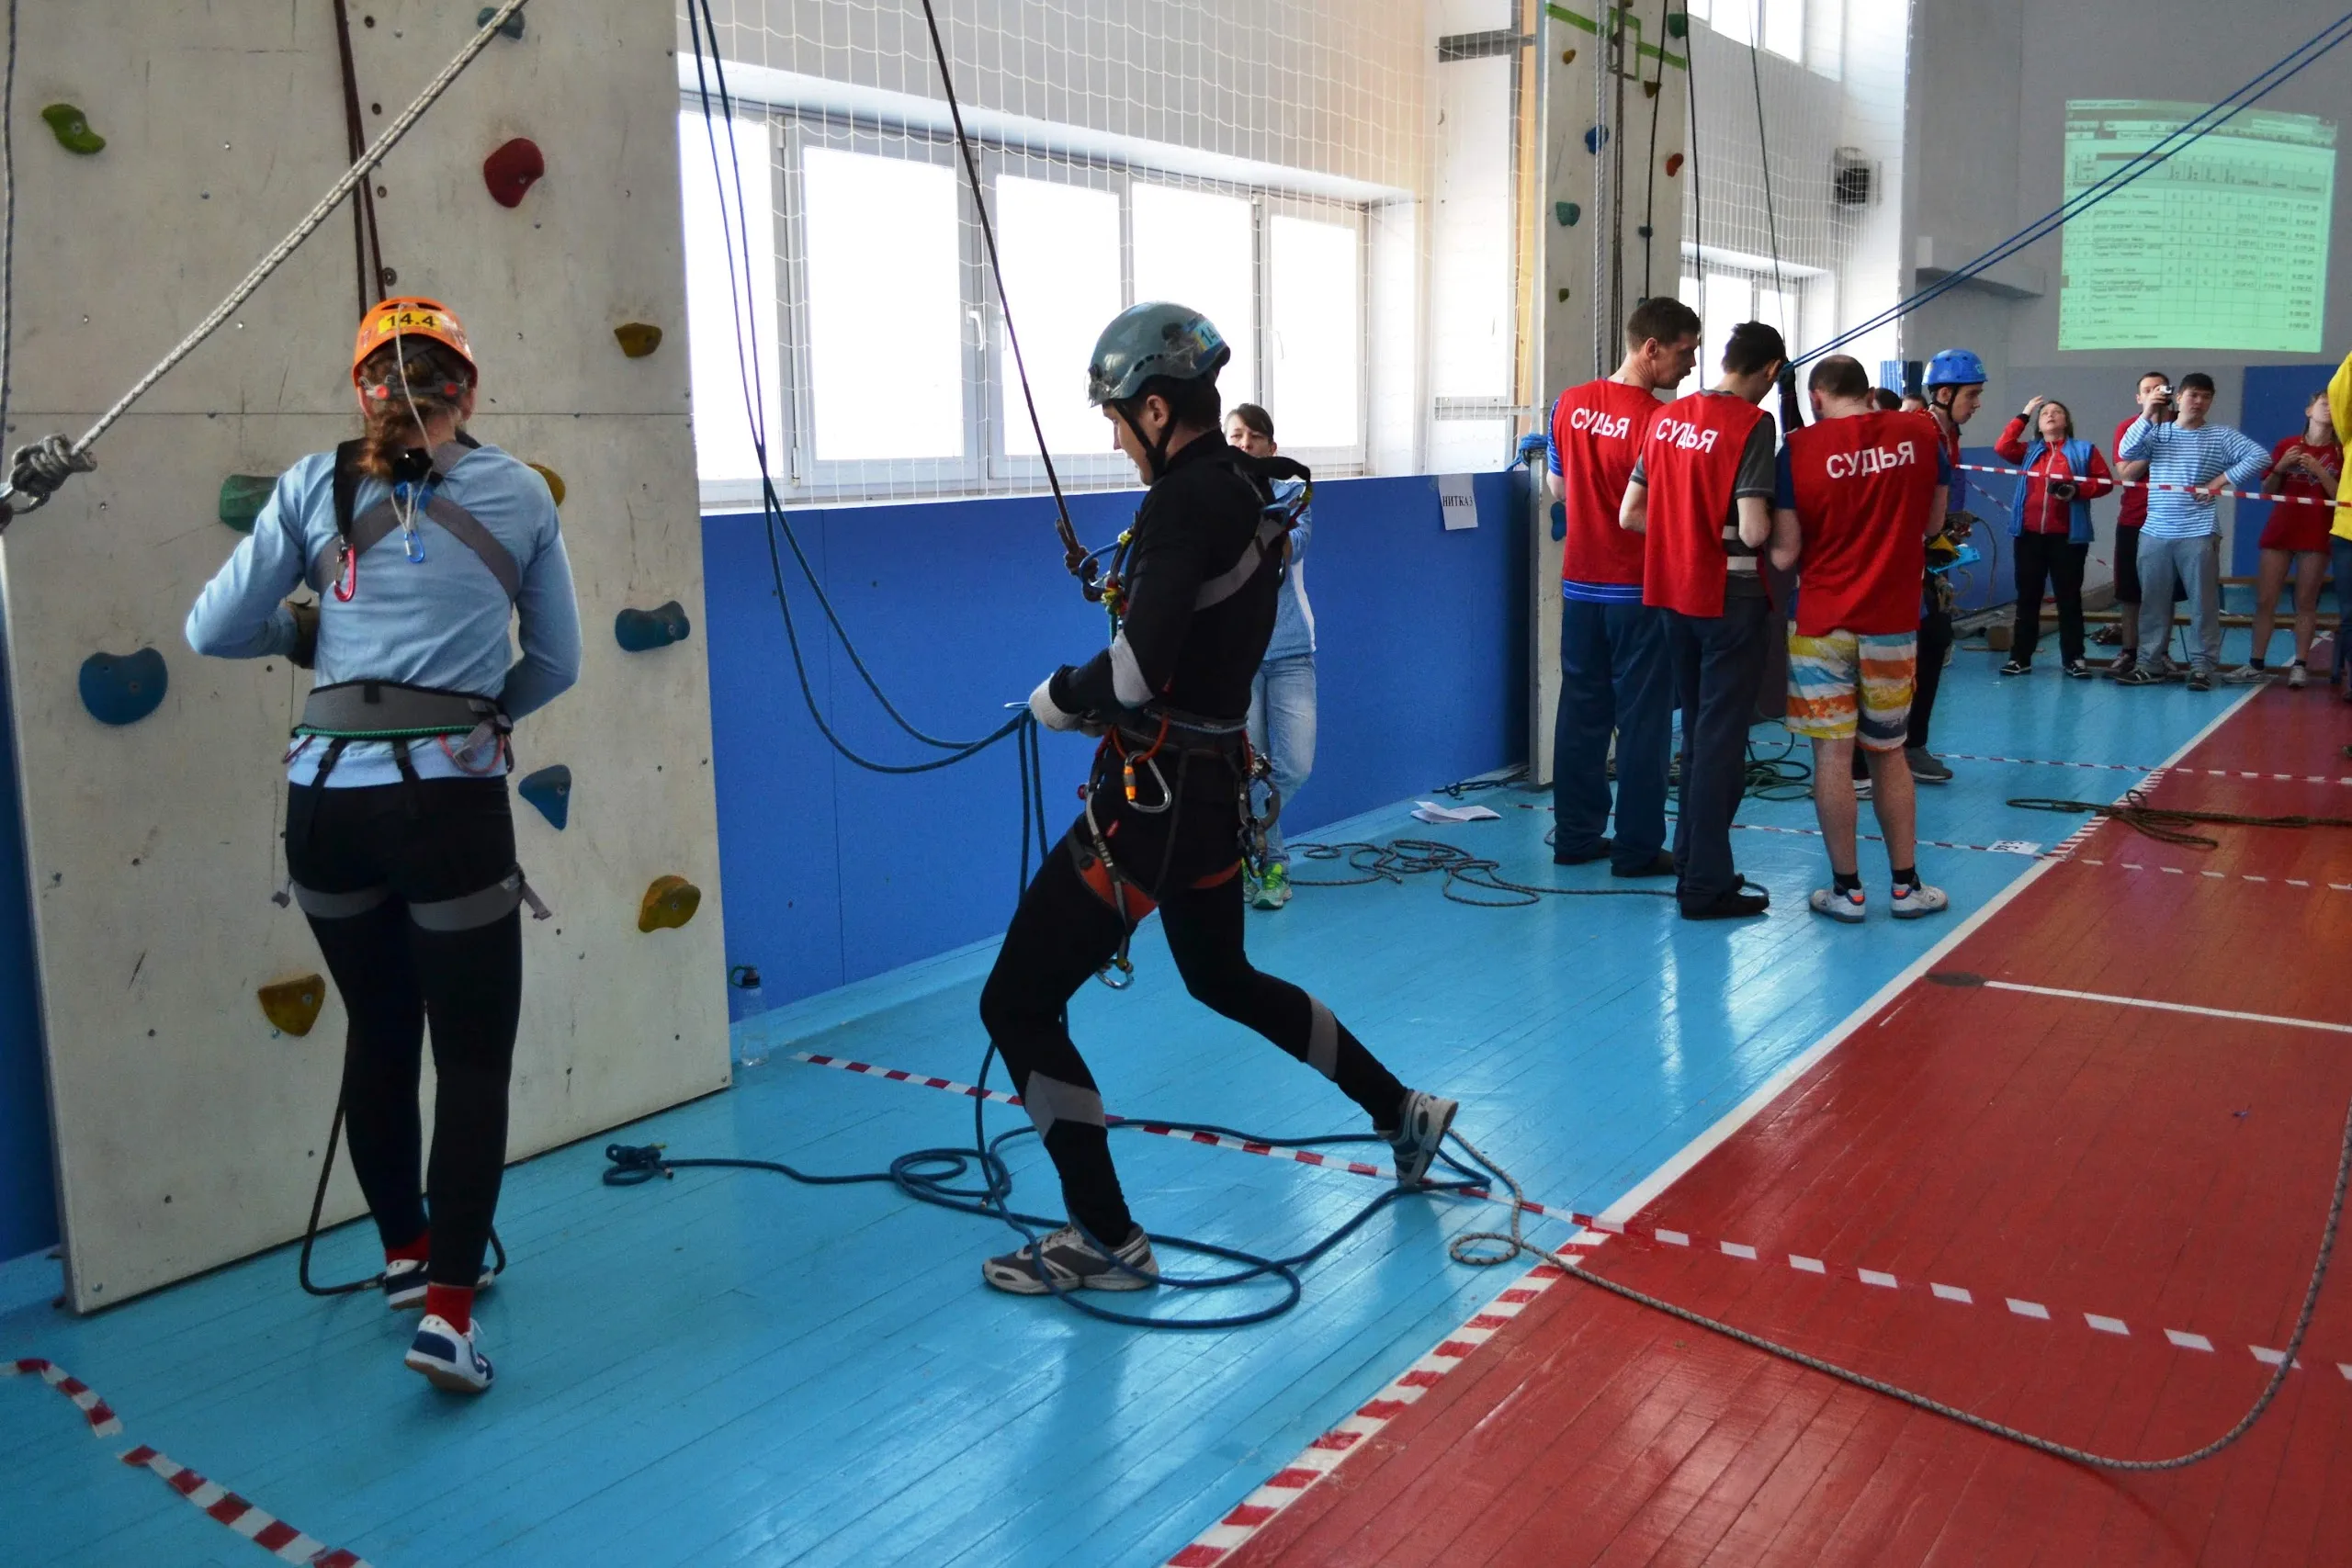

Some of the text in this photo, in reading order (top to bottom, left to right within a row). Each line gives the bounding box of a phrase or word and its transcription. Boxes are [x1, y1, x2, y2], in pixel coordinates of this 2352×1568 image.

[387, 313, 435, 327] 14.4
[1570, 407, 1631, 440] СУДЬЯ
[1656, 418, 1719, 454] СУДЬЯ
[1826, 440, 1916, 479] СУДЬЯ
